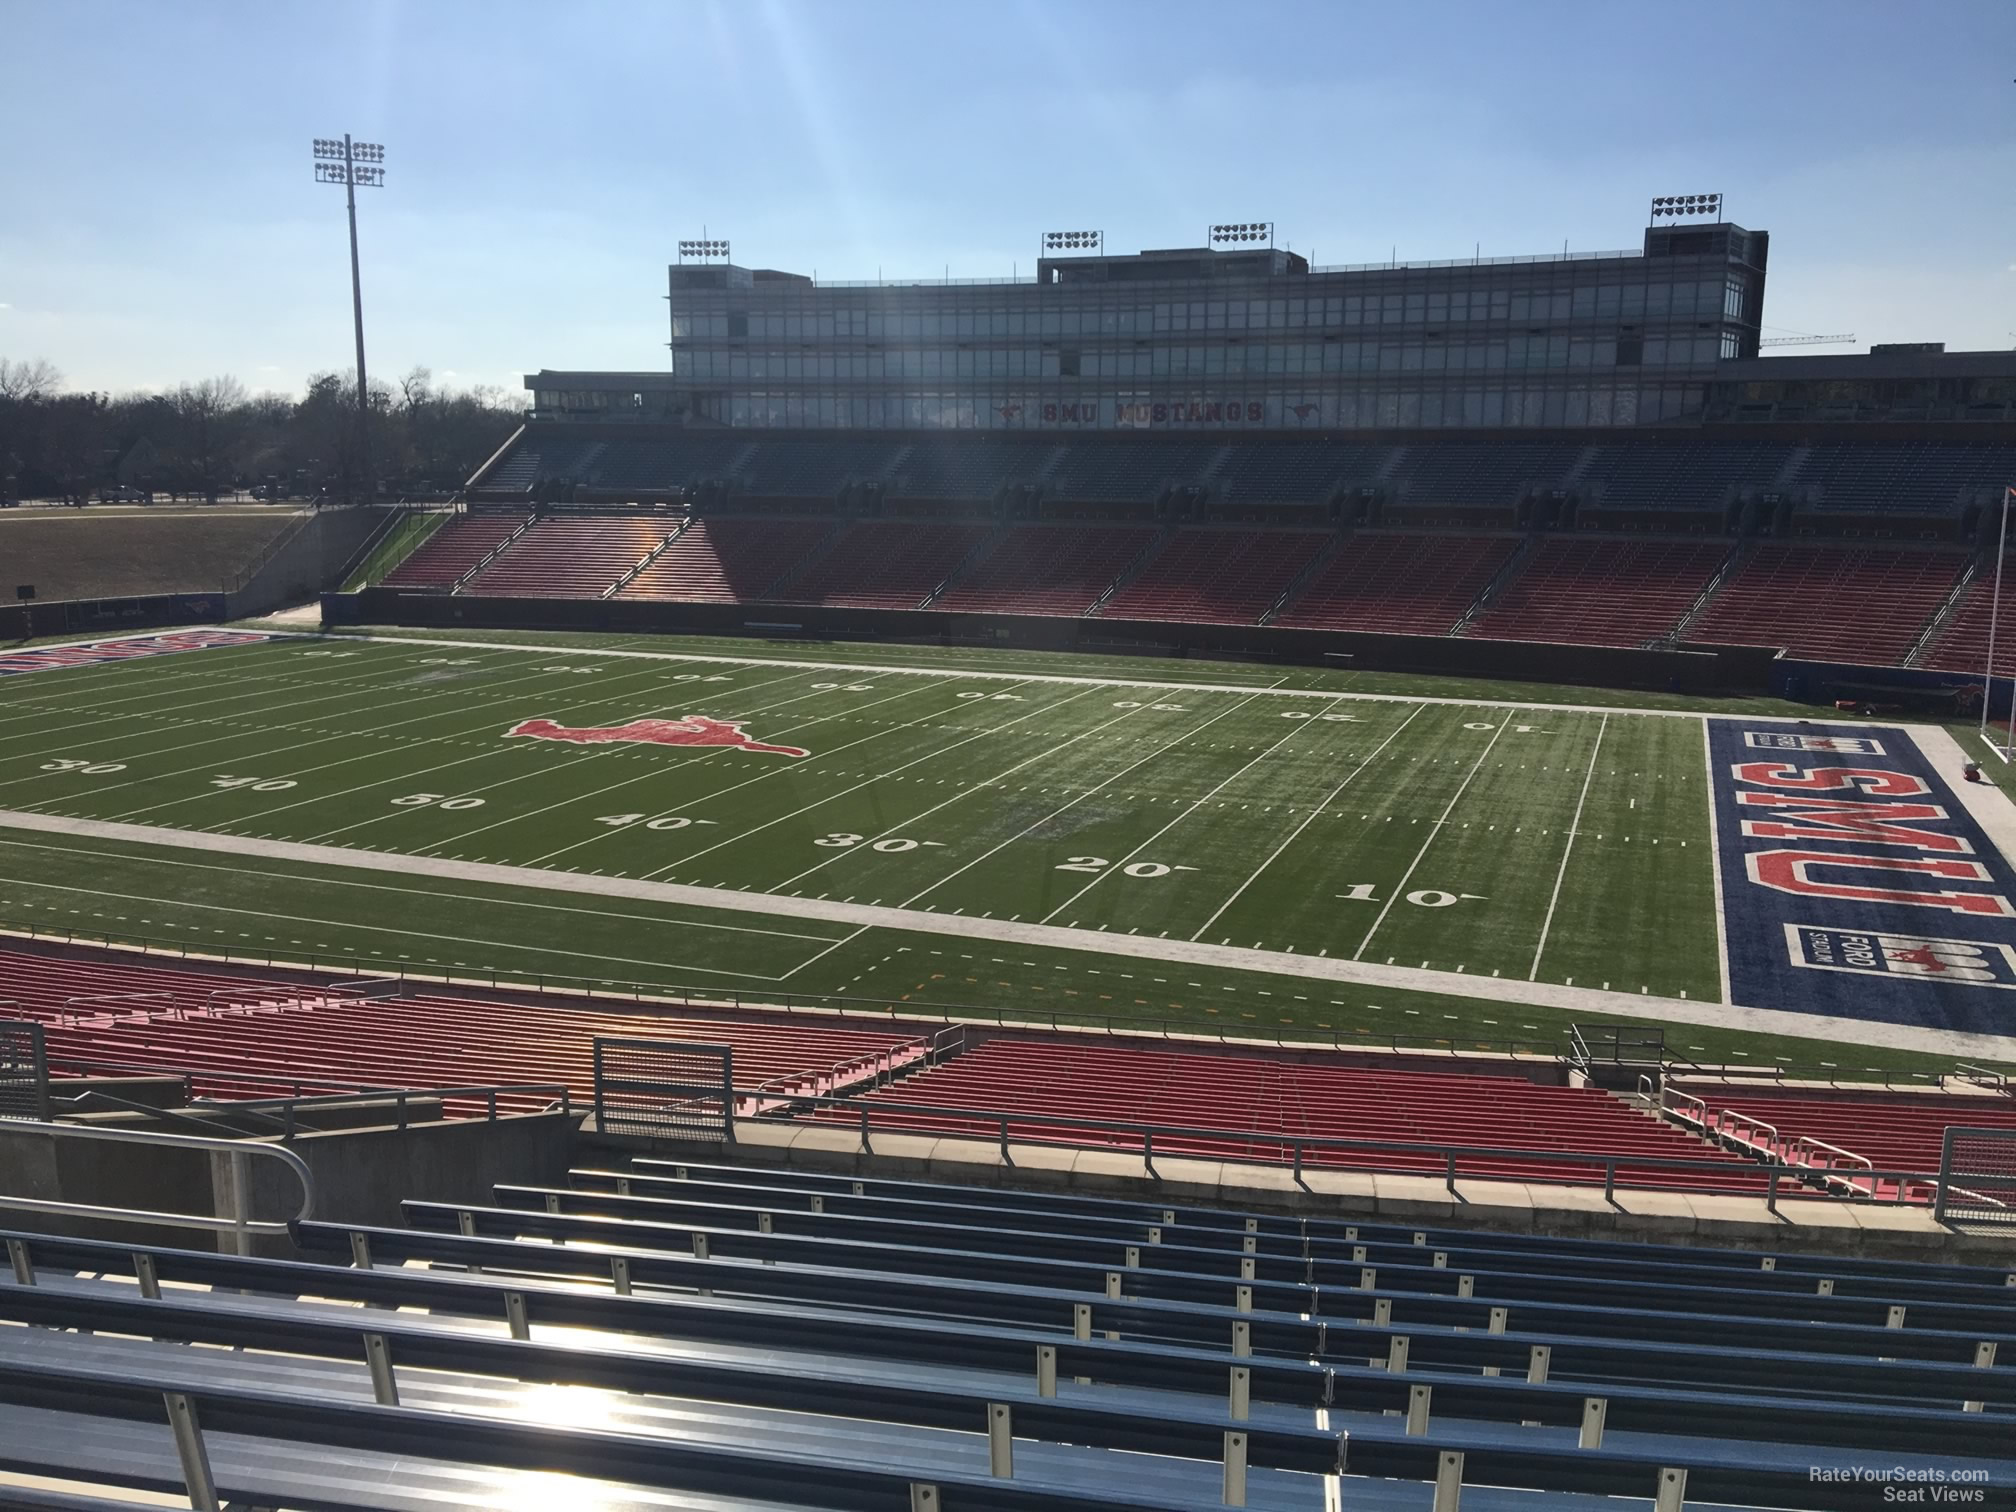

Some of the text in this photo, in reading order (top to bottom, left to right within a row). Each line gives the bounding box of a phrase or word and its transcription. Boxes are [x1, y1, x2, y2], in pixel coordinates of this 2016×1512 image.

[1043, 403, 1263, 423] SMU MUSTANGS
[390, 793, 486, 810] 50
[593, 813, 692, 830] 40
[813, 833, 919, 852] 30
[1731, 761, 2016, 918] SMU
[1054, 856, 1171, 878] 20
[1335, 883, 1458, 907] 10
[1809, 932, 1834, 963] STADIUM
[1839, 935, 1877, 967] FORD
